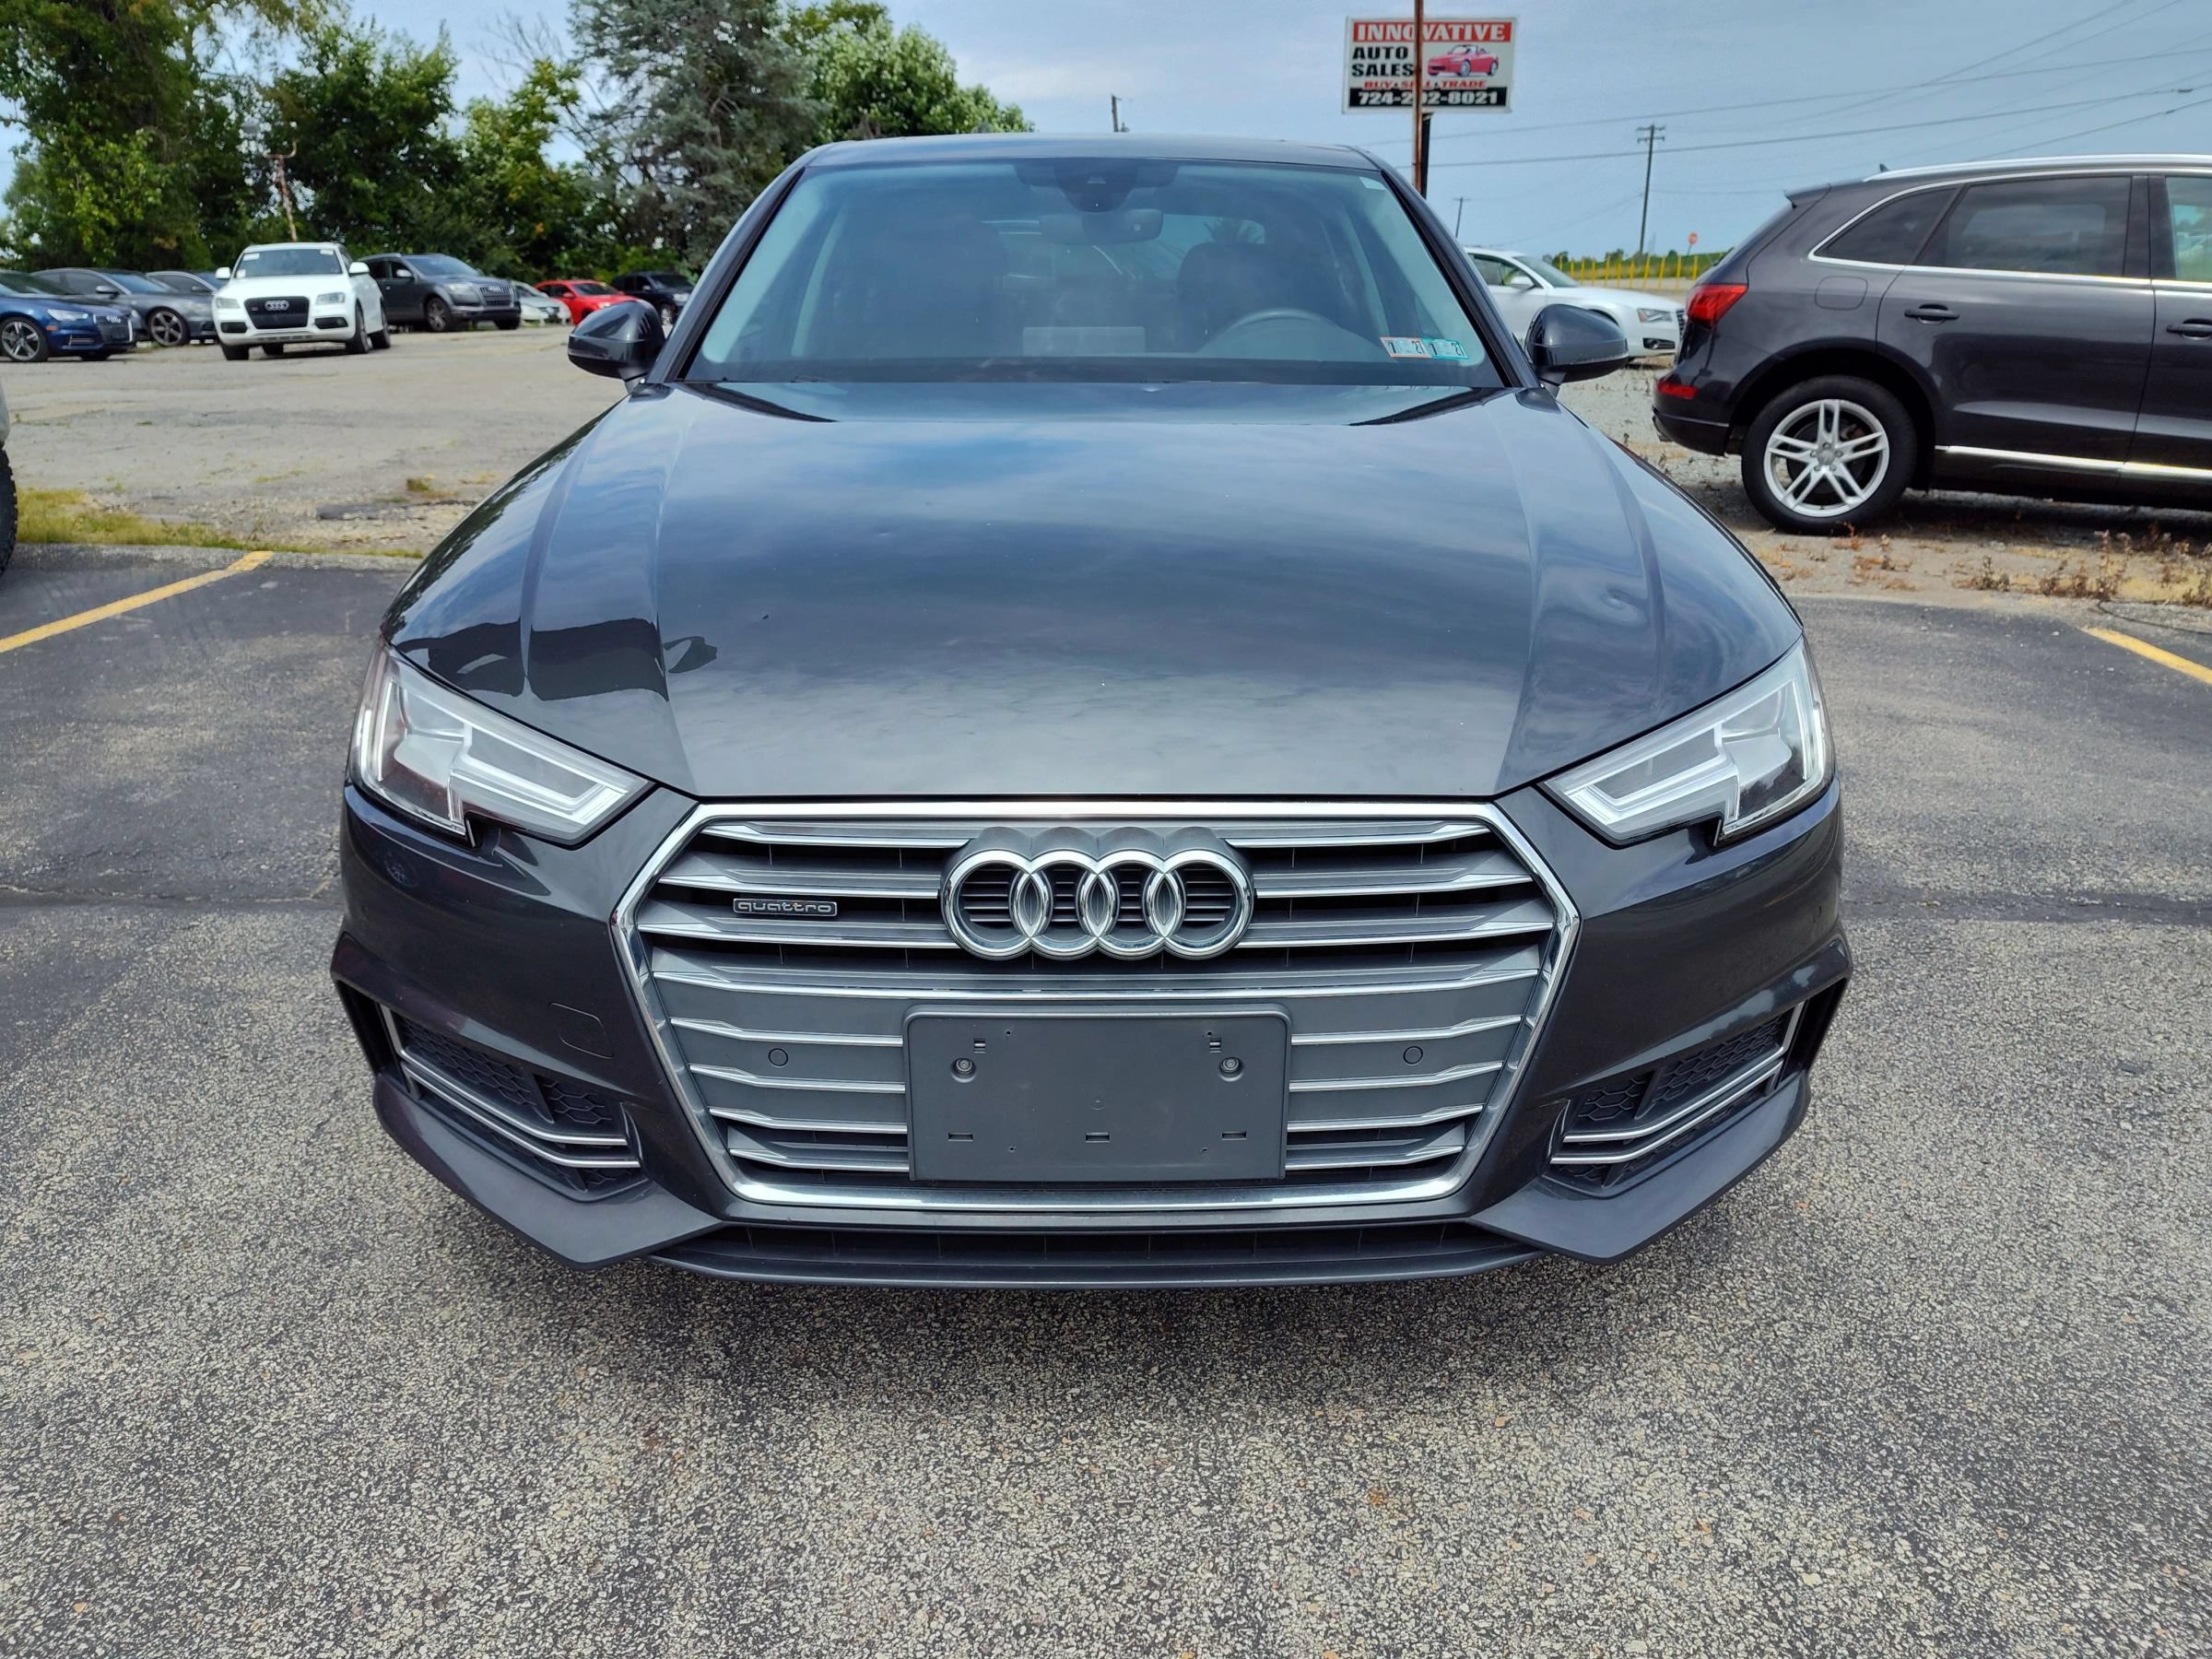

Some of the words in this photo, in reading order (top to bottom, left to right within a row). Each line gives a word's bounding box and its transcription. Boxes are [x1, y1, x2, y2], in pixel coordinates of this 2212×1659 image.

[1358, 24, 1505, 41] INNOVATIVE
[1352, 46, 1408, 60] AUTO
[1351, 64, 1415, 76] SALES
[1441, 79, 1487, 88] TRADE
[737, 901, 831, 912] quattro
